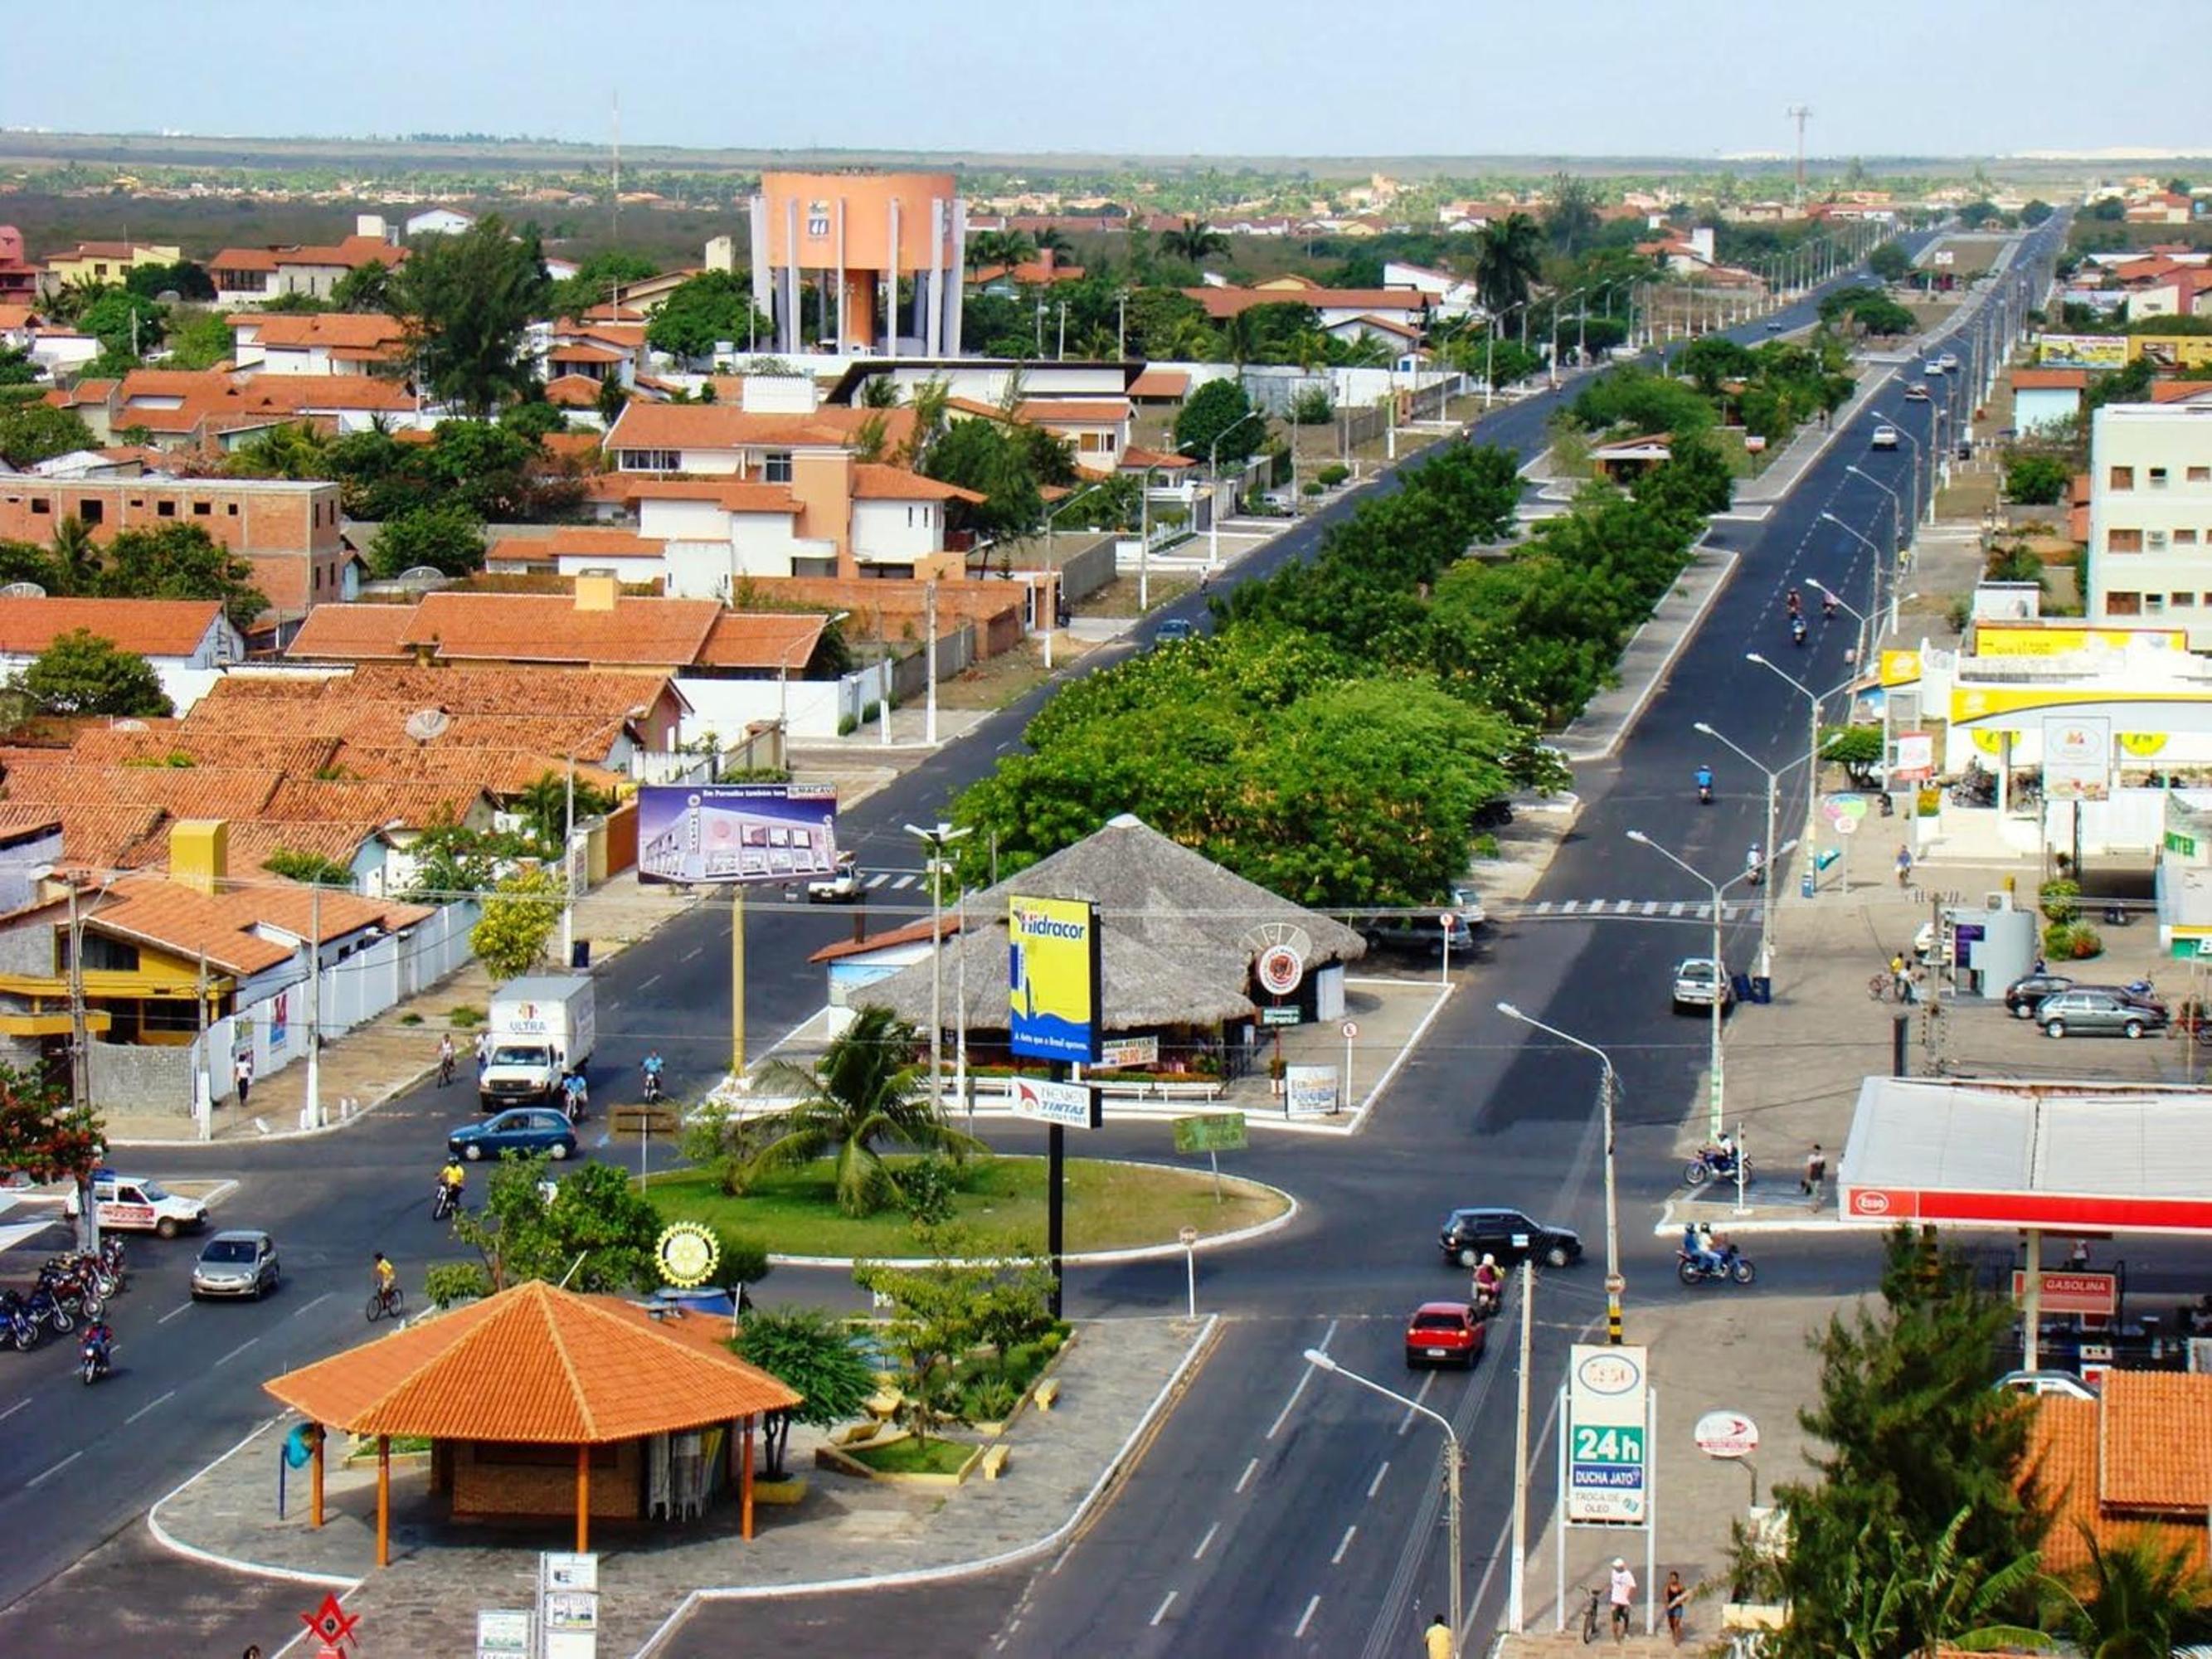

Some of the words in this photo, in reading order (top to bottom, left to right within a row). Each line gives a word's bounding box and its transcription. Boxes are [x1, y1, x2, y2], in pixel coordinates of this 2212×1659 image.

[1022, 913, 1085, 939] Hidracor
[510, 1021, 545, 1030] ULTRA
[1043, 1101, 1085, 1115] TINTAS
[2046, 1278, 2106, 1292] GASOLINA
[1576, 1471, 1608, 1485] DUCHA
[1610, 1472, 1633, 1485] JATO
